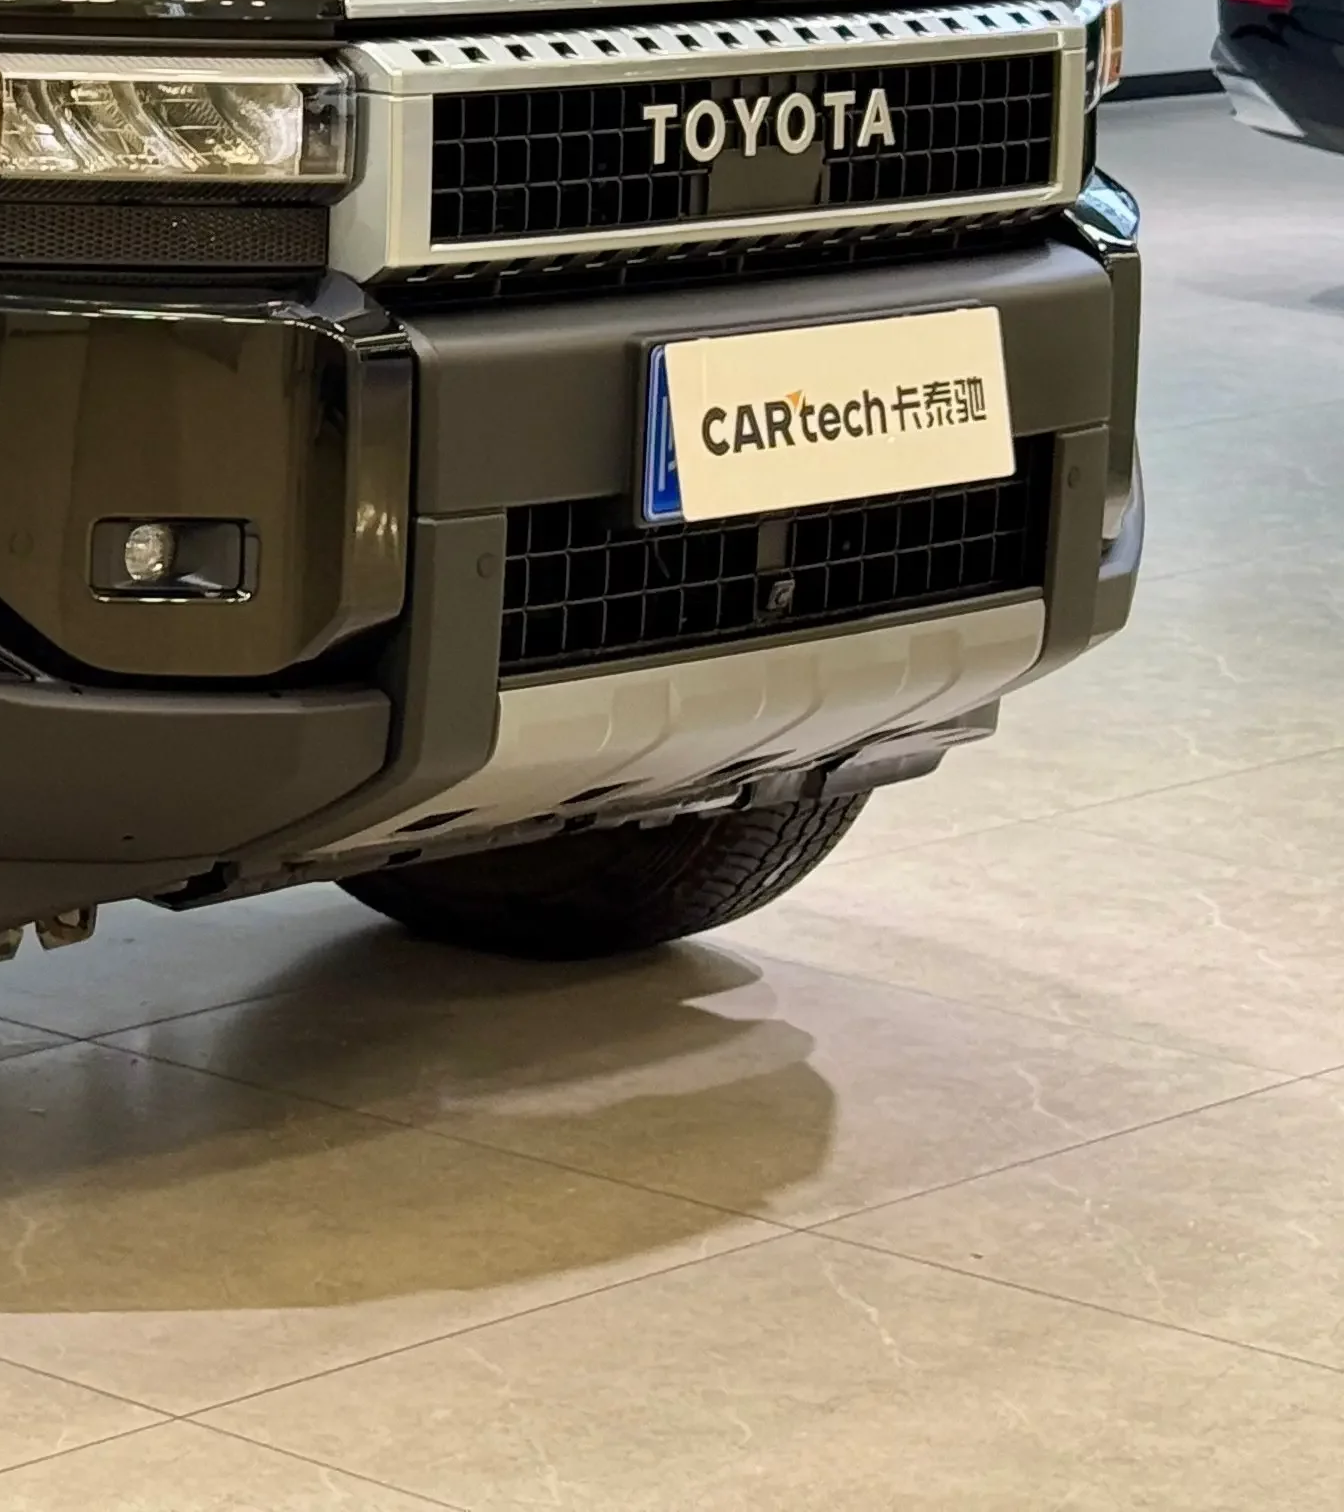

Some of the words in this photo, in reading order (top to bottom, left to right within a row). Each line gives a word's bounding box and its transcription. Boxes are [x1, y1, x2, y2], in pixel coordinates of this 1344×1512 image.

[643, 88, 895, 165] TOYOTA
[701, 389, 888, 457] CARtech
[890, 376, 988, 432] 卡泰驰
